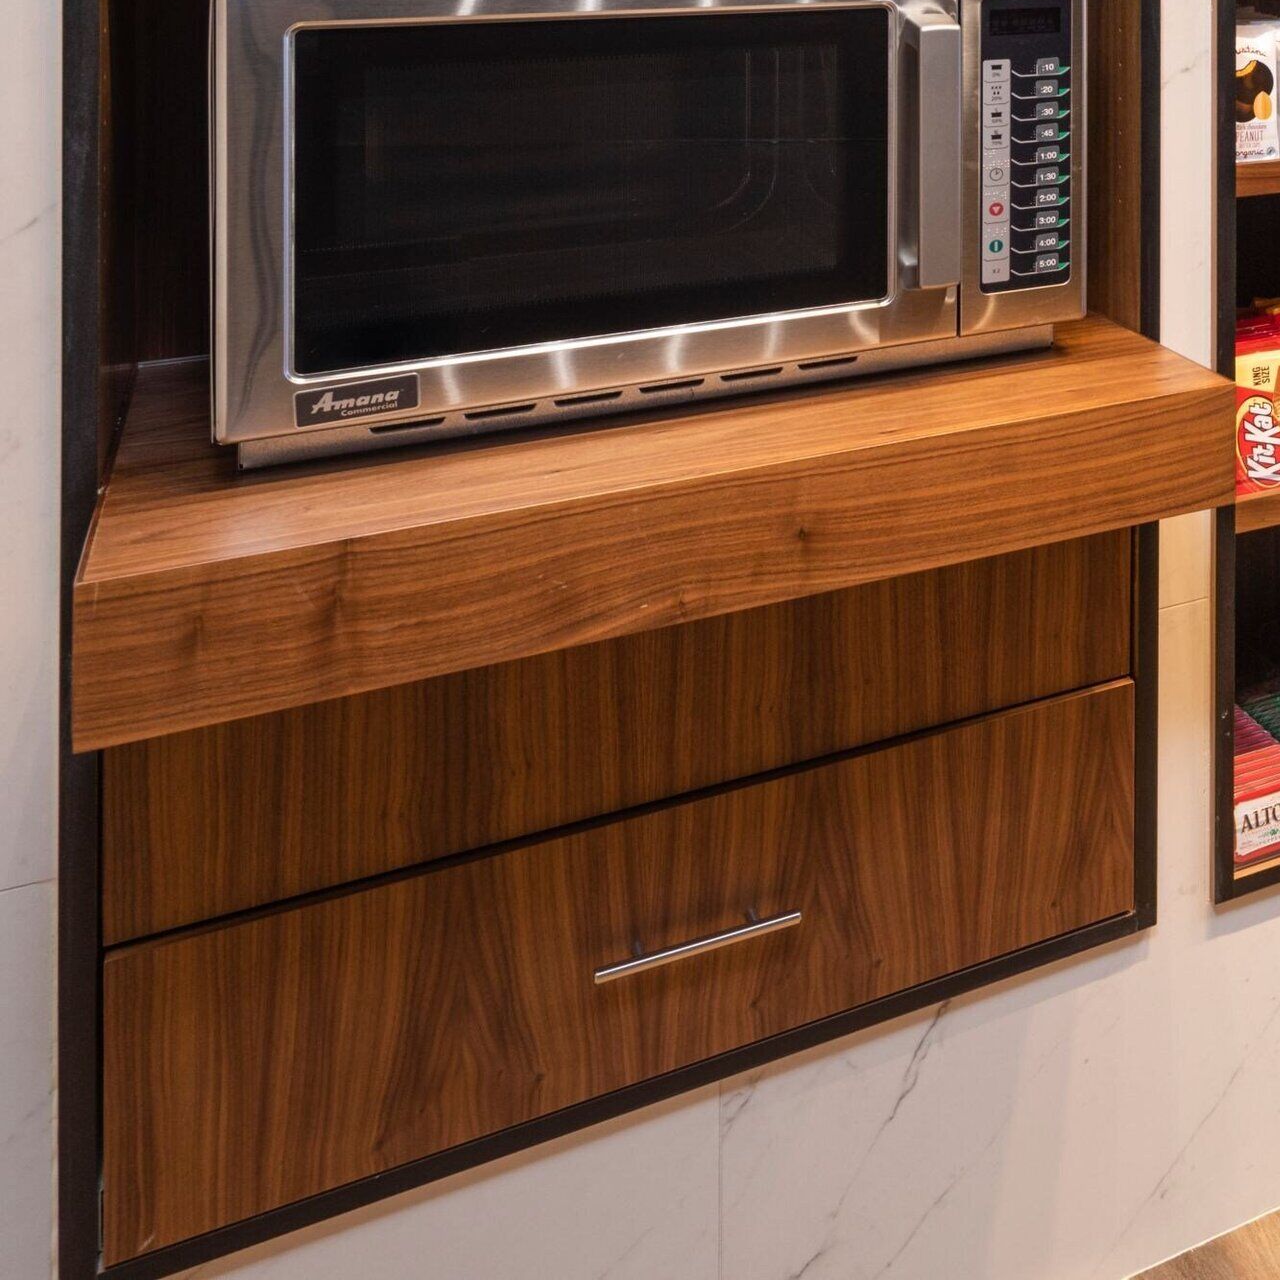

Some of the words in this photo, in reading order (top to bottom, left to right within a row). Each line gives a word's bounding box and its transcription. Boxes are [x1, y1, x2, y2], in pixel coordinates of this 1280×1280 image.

[1040, 151, 1057, 160] 1:00
[1040, 173, 1057, 181] 1:30
[1039, 194, 1057, 202] 2:00
[1039, 216, 1056, 224] 3:00
[1039, 238, 1056, 247] 4:00
[1039, 259, 1056, 268] 5:00
[1252, 366, 1262, 386] KING
[1262, 365, 1271, 384] SIZE
[311, 388, 401, 415] Amana
[340, 400, 398, 417] Commercial
